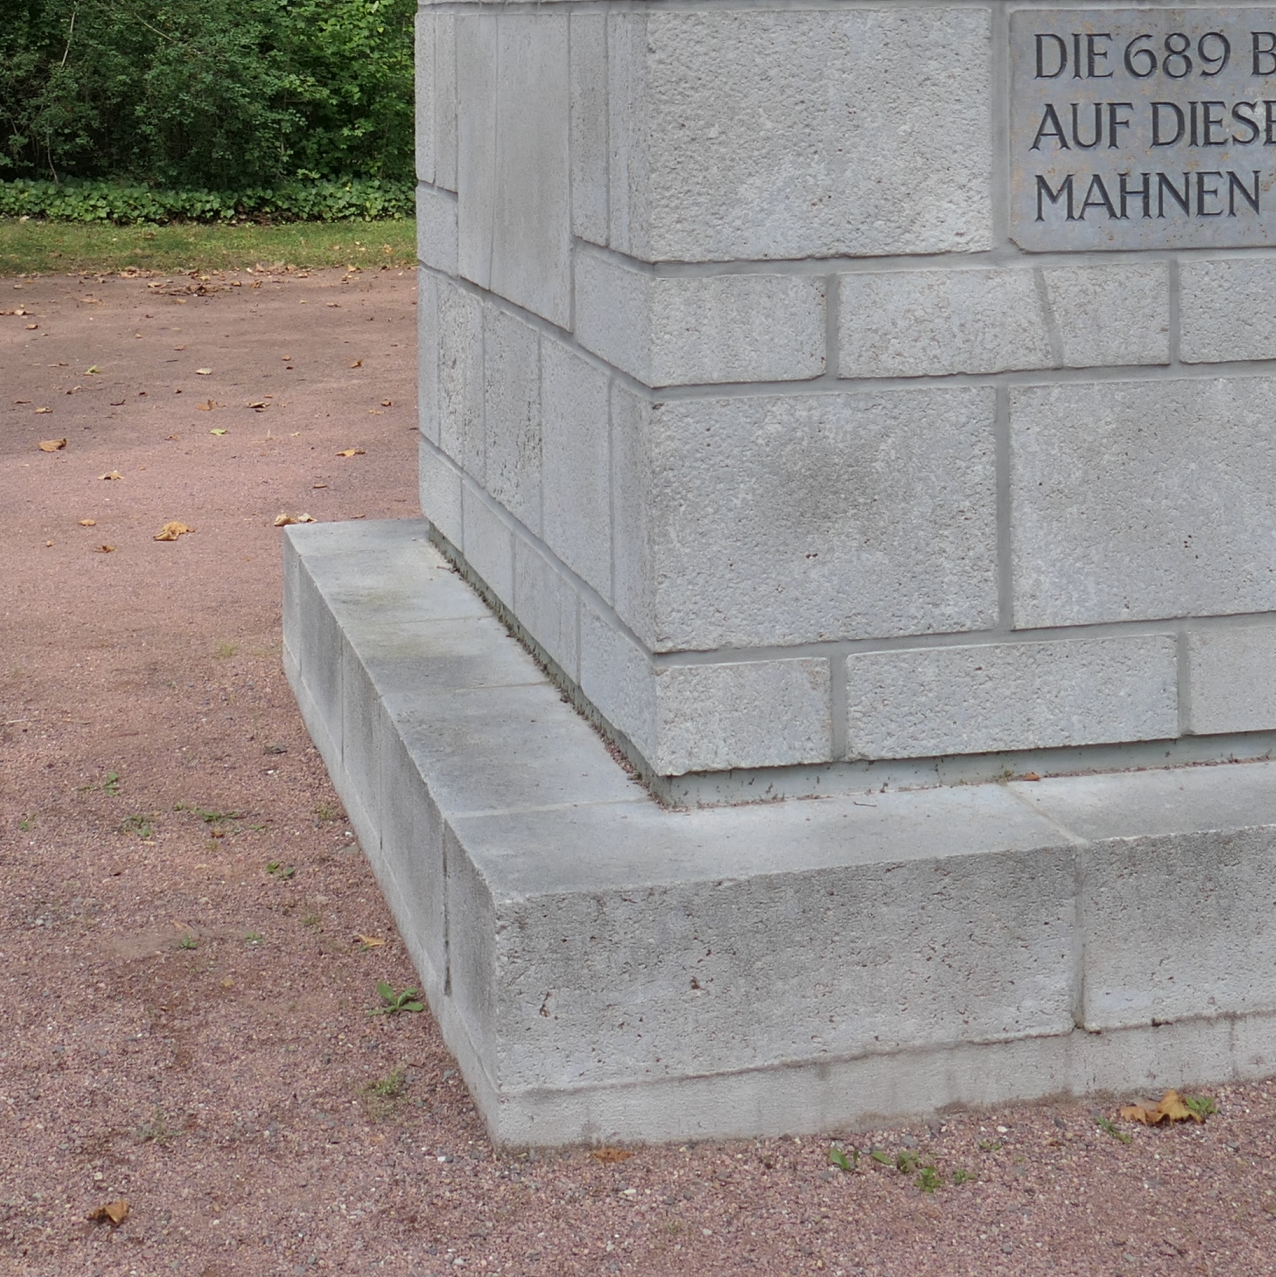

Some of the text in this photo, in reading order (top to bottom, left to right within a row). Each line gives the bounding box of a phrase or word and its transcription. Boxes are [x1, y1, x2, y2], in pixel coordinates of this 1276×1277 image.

[1034, 32, 1114, 80] DIE
[1123, 31, 1231, 79] 689
[1028, 101, 1133, 152] AUF
[1034, 169, 1261, 222] MAHNEN
